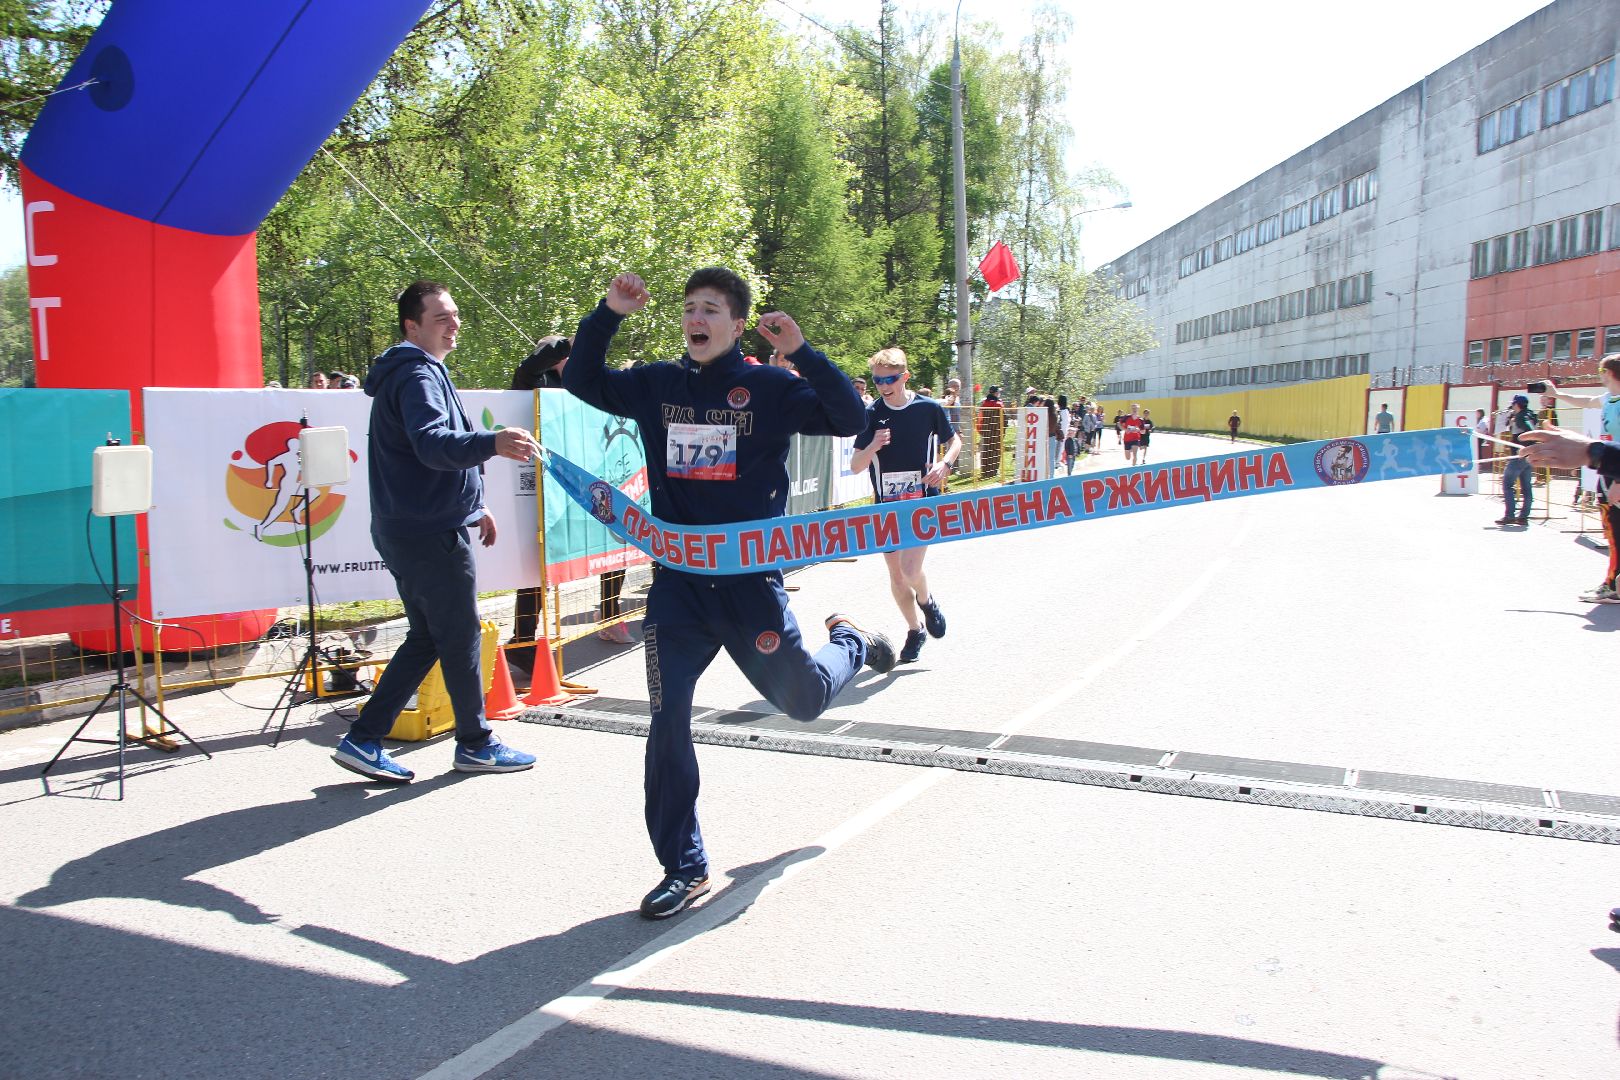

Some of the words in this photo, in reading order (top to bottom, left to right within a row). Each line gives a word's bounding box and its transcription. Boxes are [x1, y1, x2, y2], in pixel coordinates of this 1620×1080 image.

[676, 444, 723, 467] 179
[1021, 412, 1038, 481] ФИНИШ
[622, 505, 727, 570] ПРОБЕГ
[738, 511, 901, 568] ПАМЯТИ
[911, 485, 1074, 542] СЕМЕНА
[1081, 451, 1294, 514] РЖИЩИНА
[889, 481, 916, 495] 276
